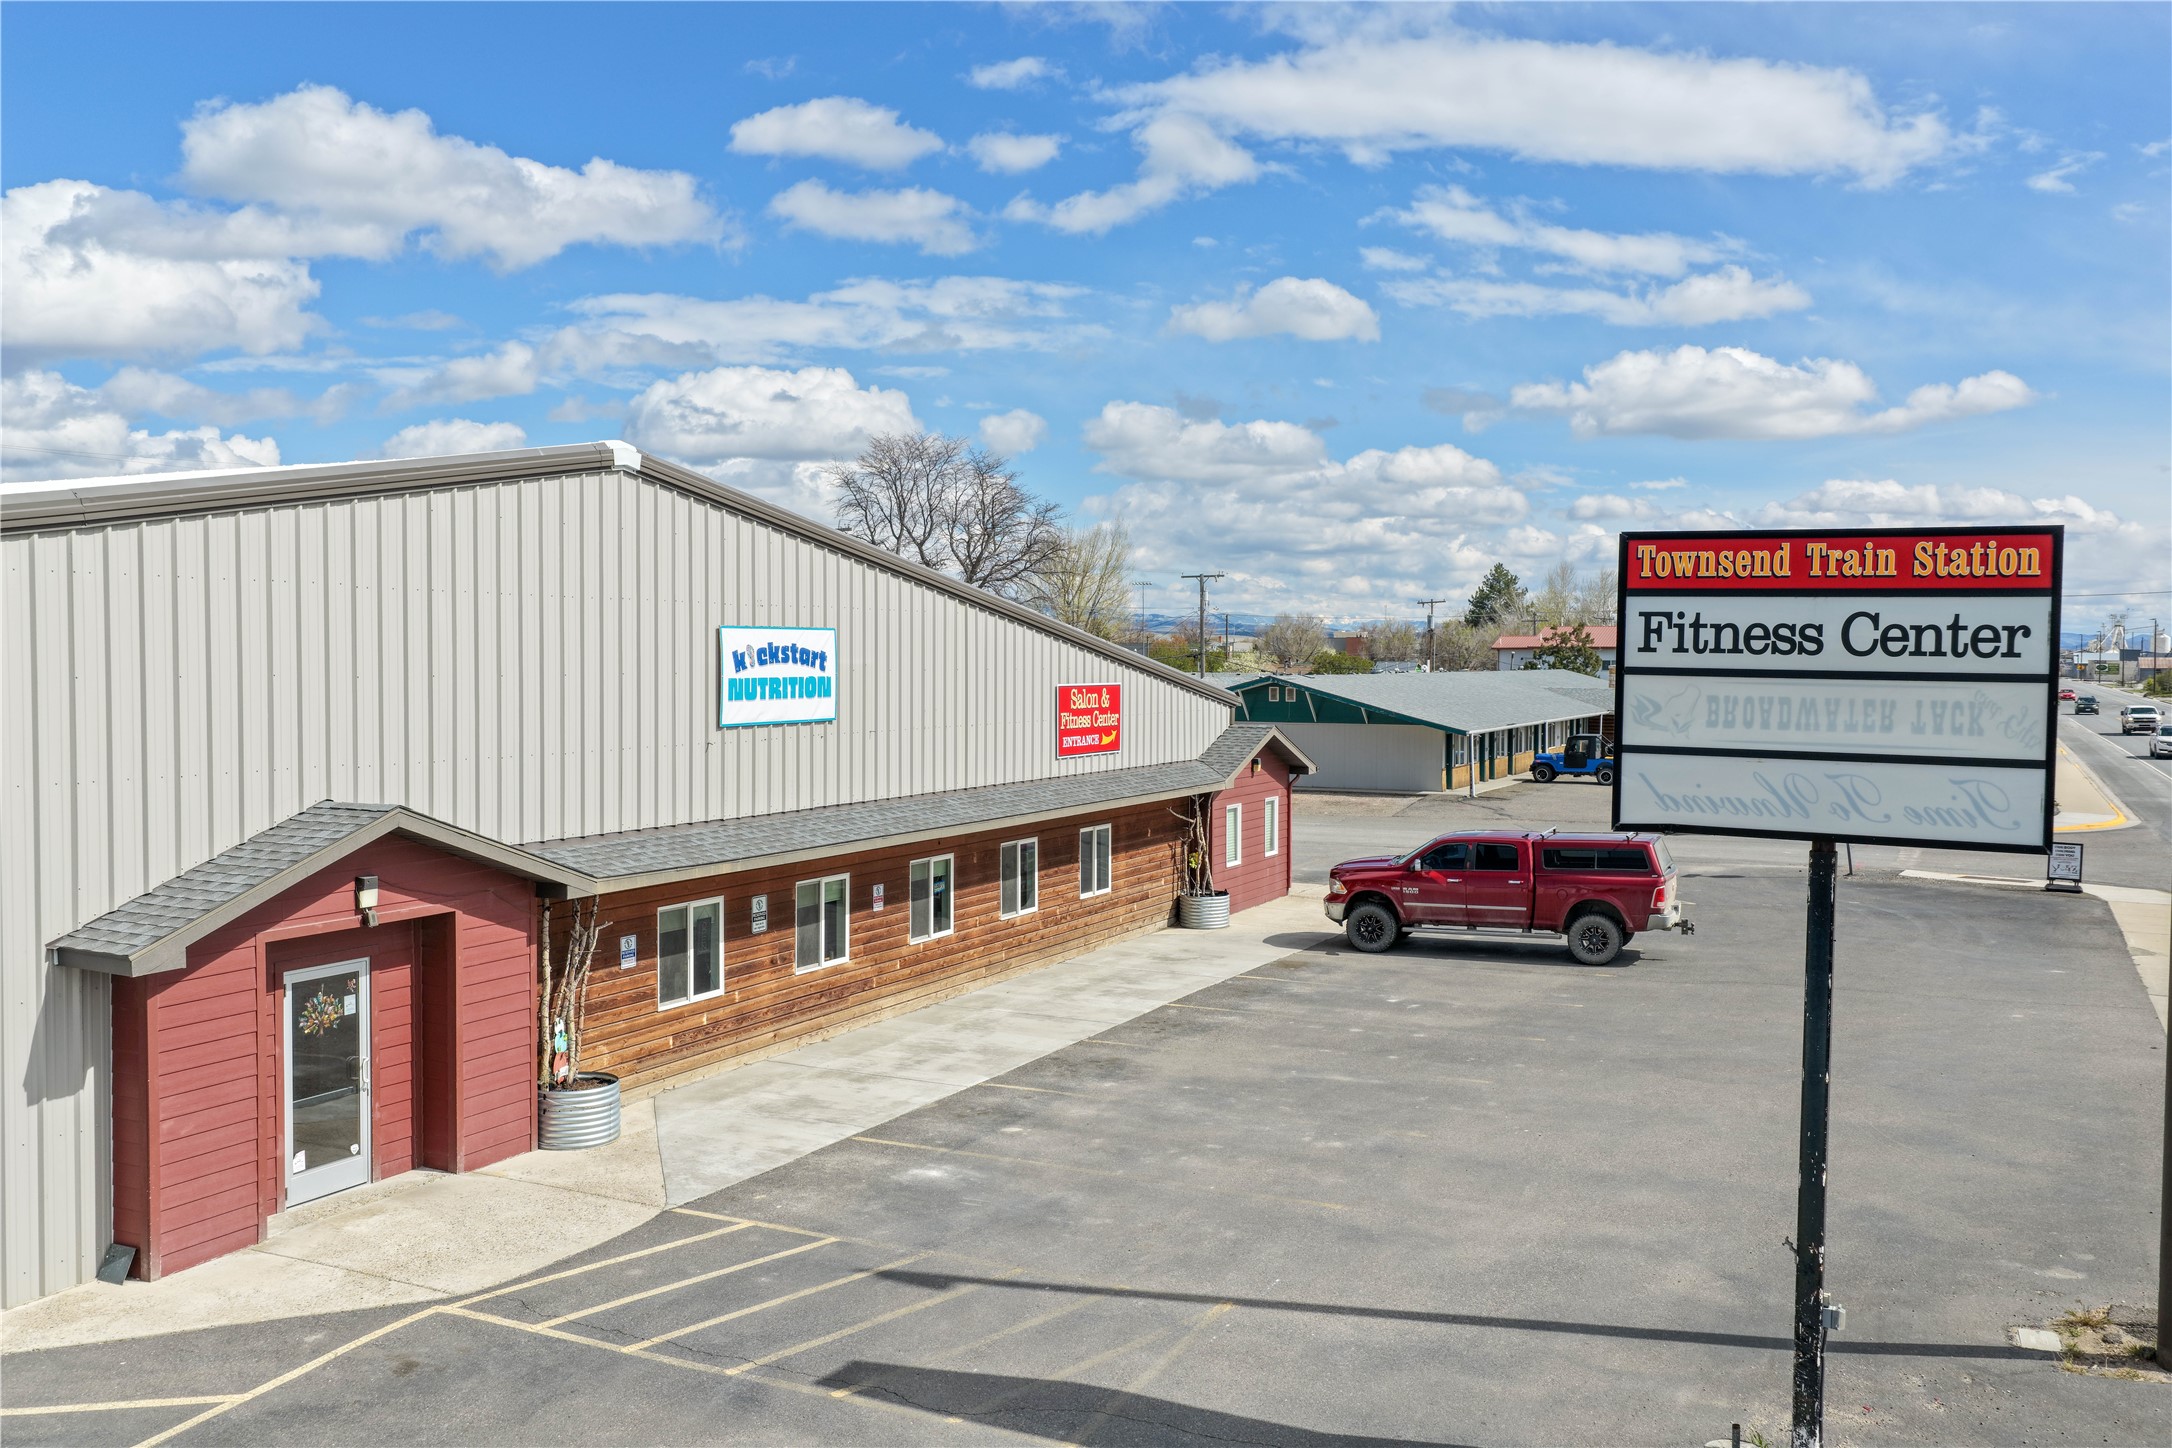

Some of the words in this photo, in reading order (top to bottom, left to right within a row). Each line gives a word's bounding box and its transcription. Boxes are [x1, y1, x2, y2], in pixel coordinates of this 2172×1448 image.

[1636, 542, 1791, 579] Townsend
[1806, 541, 1897, 578] Train
[1913, 540, 2041, 578] Station
[1637, 610, 1824, 656] Fitness
[1841, 610, 2031, 659] Center
[727, 675, 832, 702] NUTRITION
[1070, 688, 1099, 710] Salon
[1101, 687, 1110, 708] &
[1060, 712, 1092, 730] Fitness
[1092, 710, 1119, 728] Center
[1062, 734, 1100, 748] ENTRANCE
